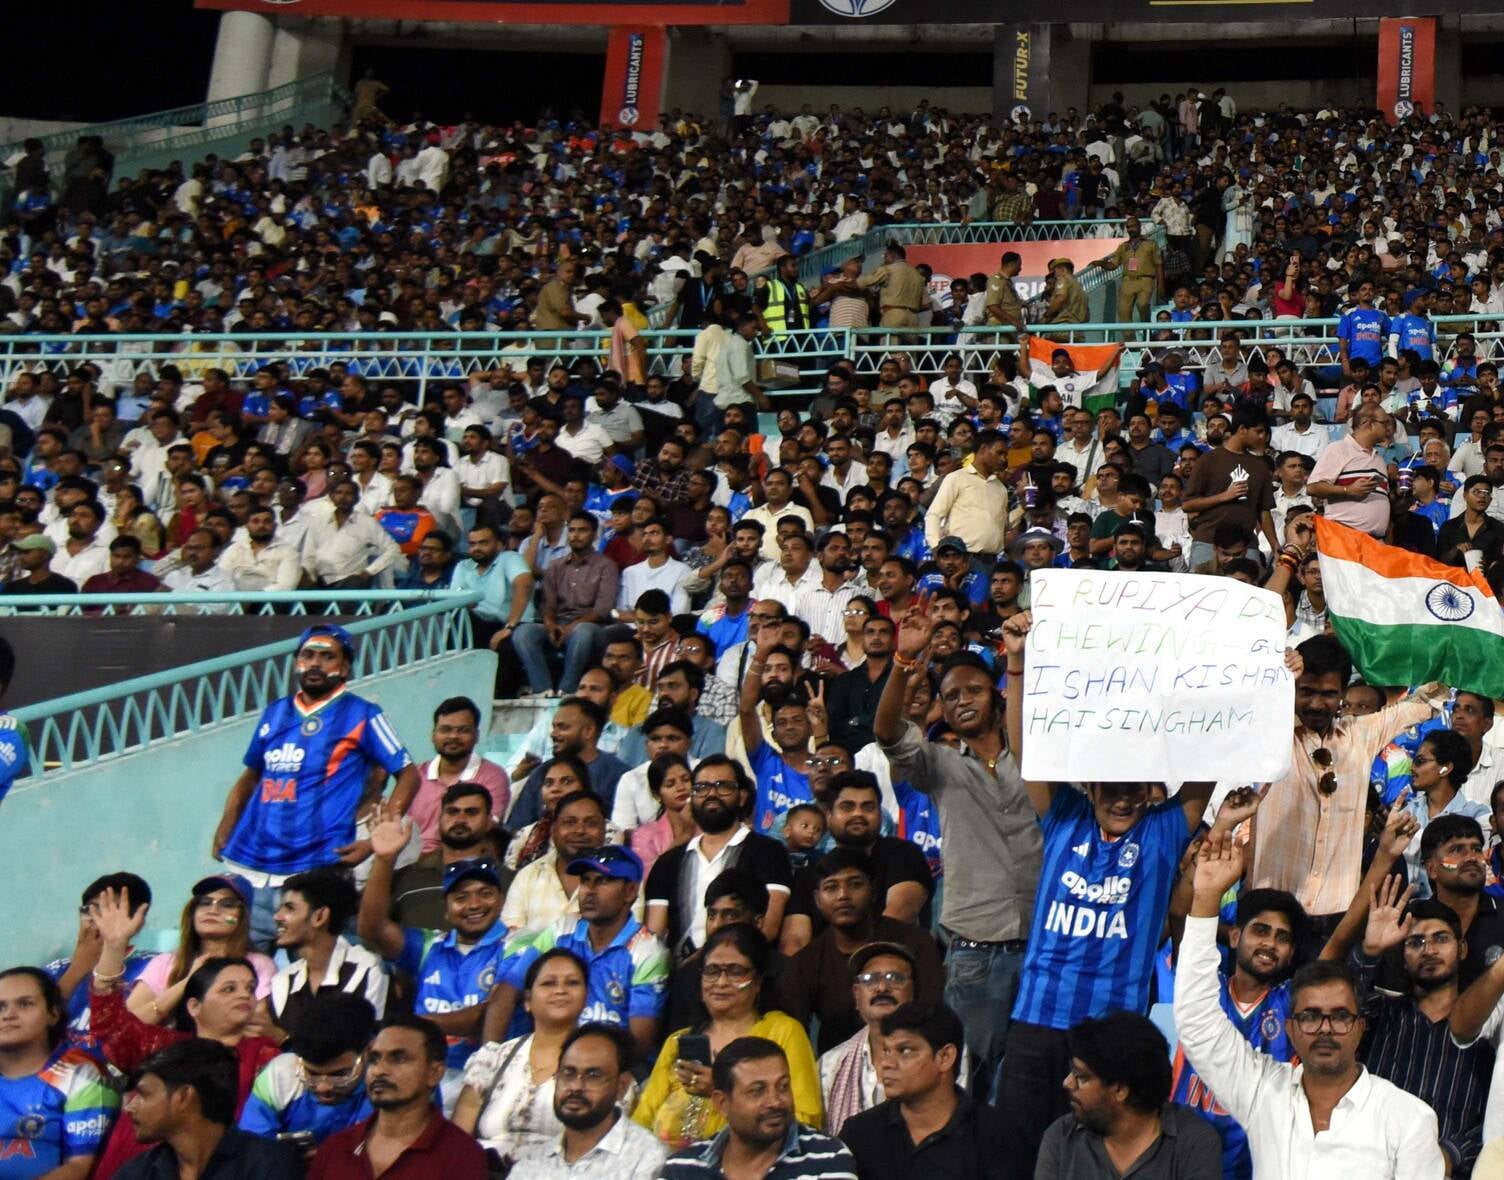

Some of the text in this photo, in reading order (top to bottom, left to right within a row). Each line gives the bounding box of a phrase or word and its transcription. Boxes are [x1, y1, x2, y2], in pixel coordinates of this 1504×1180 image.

[626, 39, 642, 104] LUBRICANTS
[1015, 31, 1028, 100] FUTUR-X
[1400, 32, 1412, 97] LUBRICANTS
[1027, 664, 1159, 700] ISHAN
[1061, 871, 1132, 898] apollo
[1045, 900, 1128, 938] INDIA
